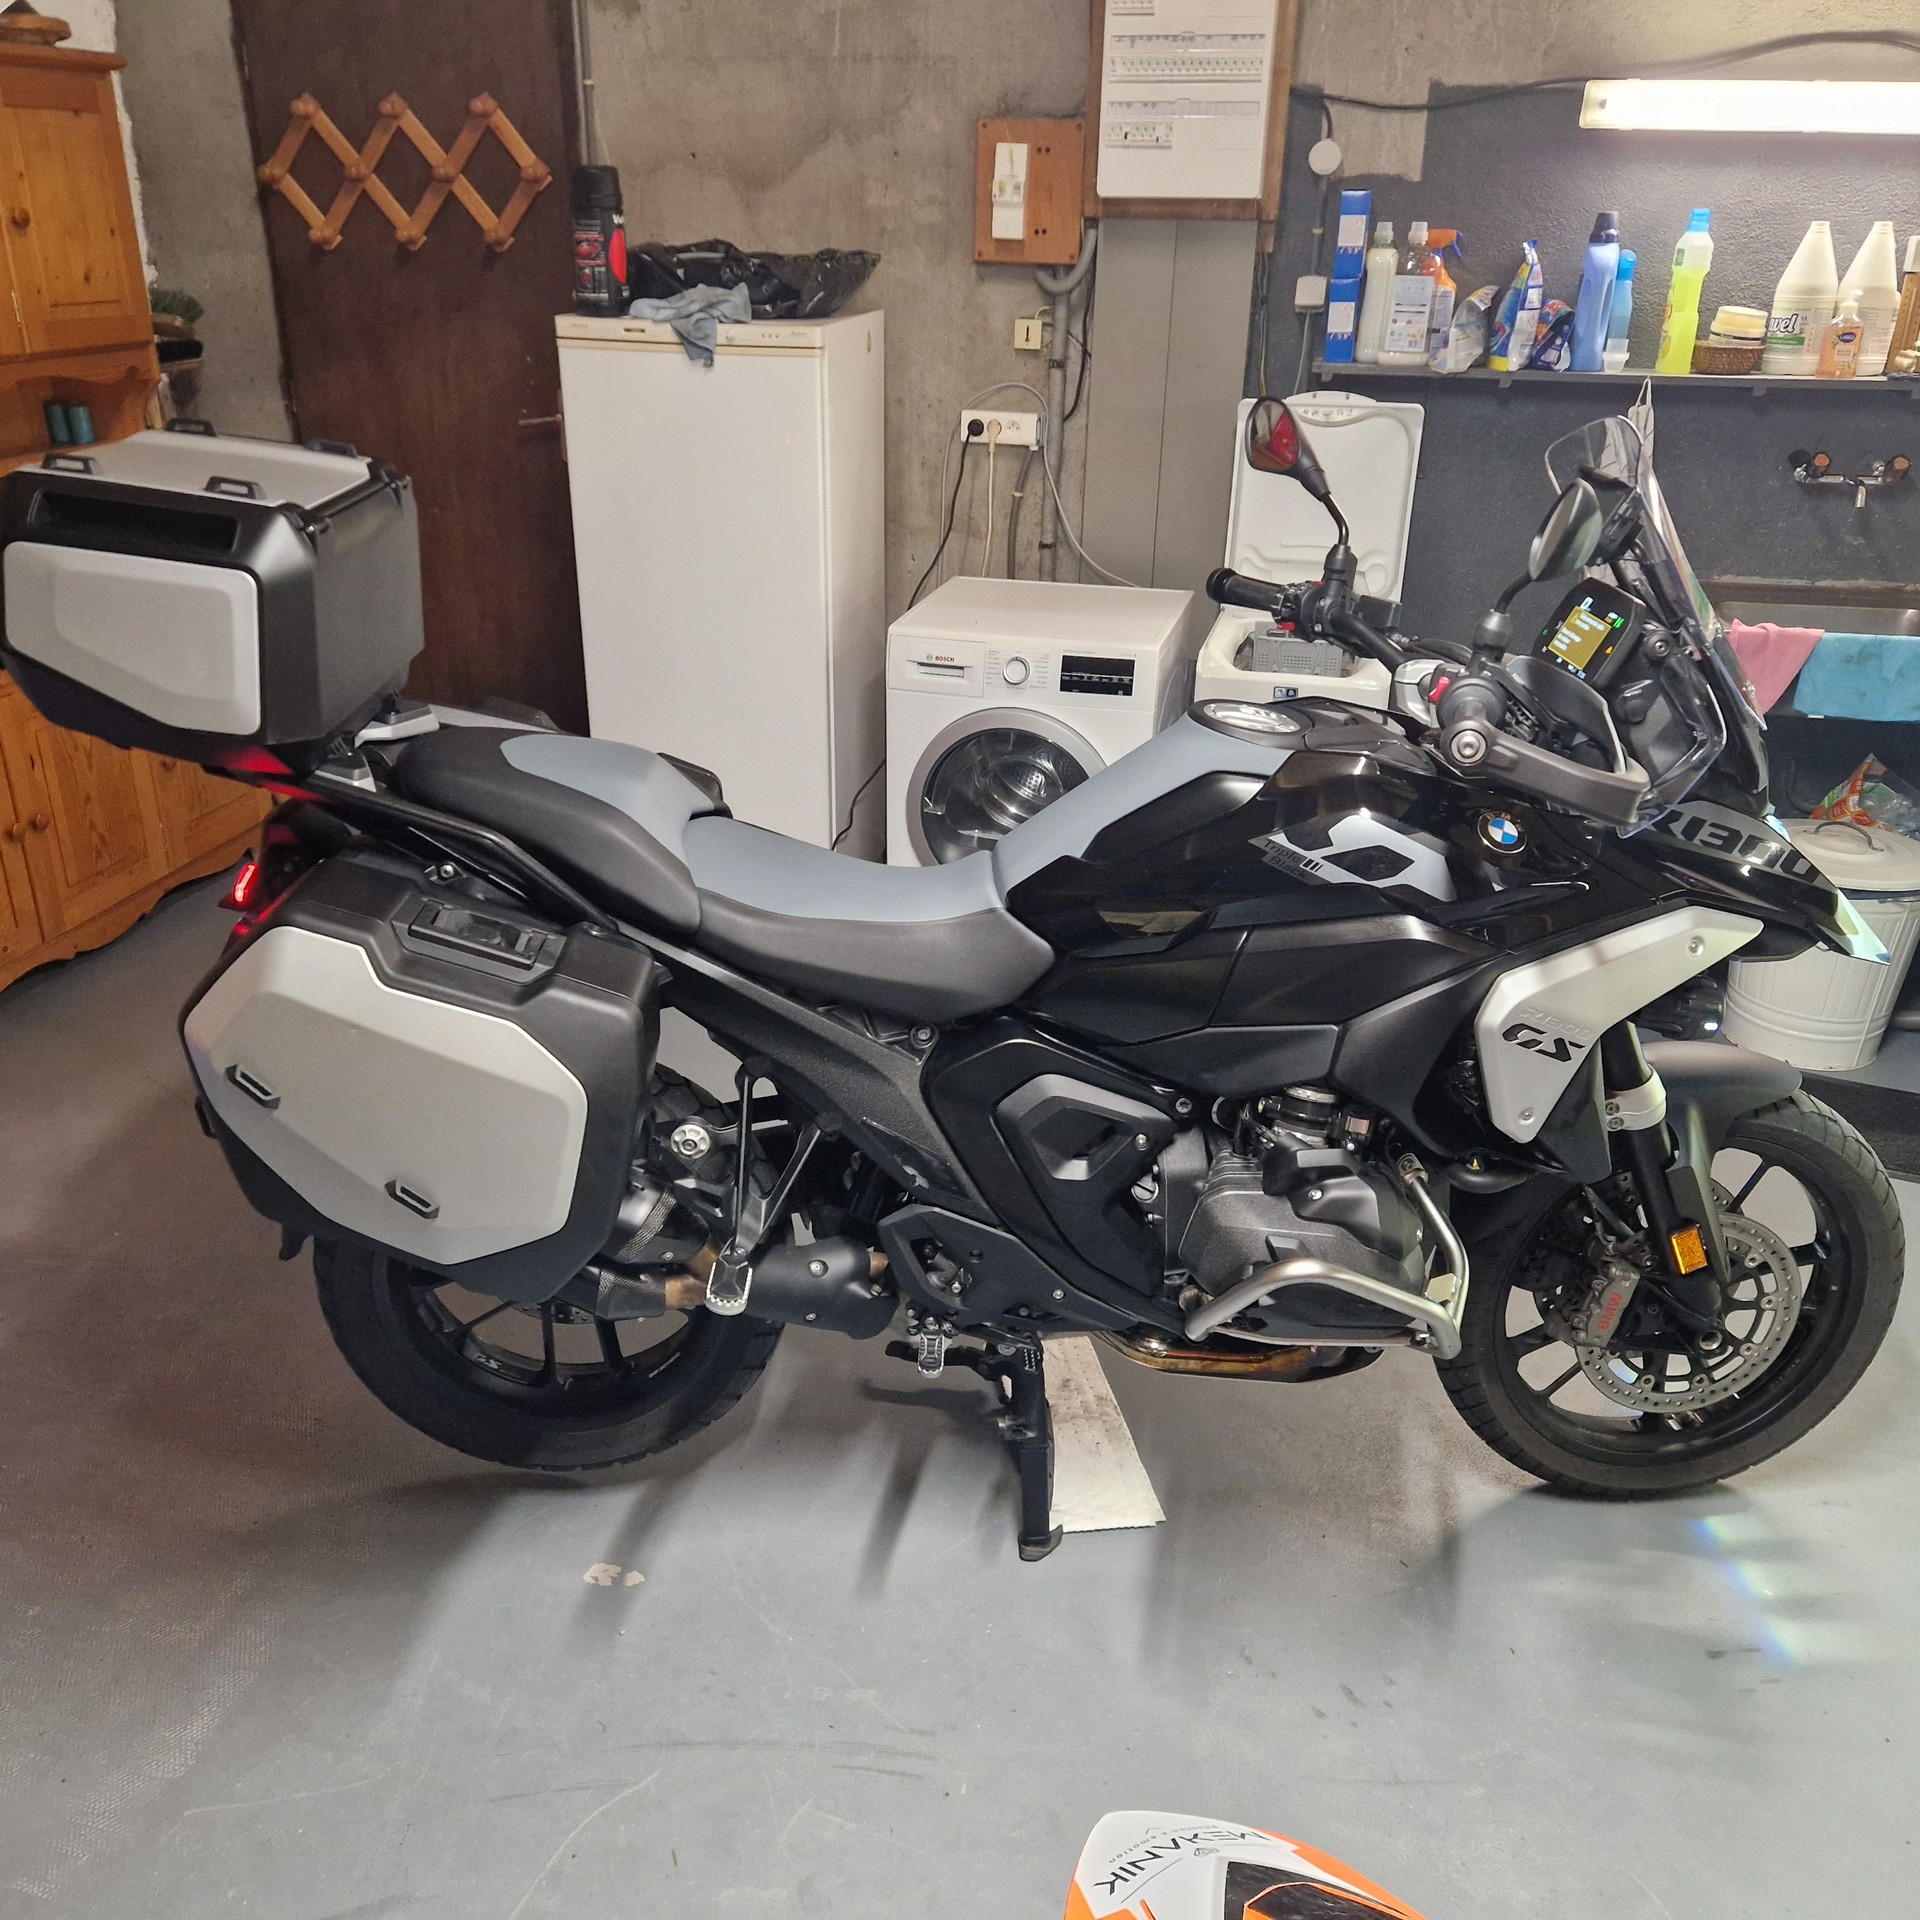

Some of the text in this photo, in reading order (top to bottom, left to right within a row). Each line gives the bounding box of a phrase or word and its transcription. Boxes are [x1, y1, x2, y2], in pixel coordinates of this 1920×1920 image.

[934, 655, 955, 663] BOSCH
[1264, 839, 1302, 864] Triple
[1269, 855, 1306, 879] Black
[1502, 1023, 1586, 1062] GS
[1596, 1292, 1623, 1331] BMW
[1092, 1830, 1271, 1896] MEKANIK
[1108, 1835, 1157, 1864] emotion
